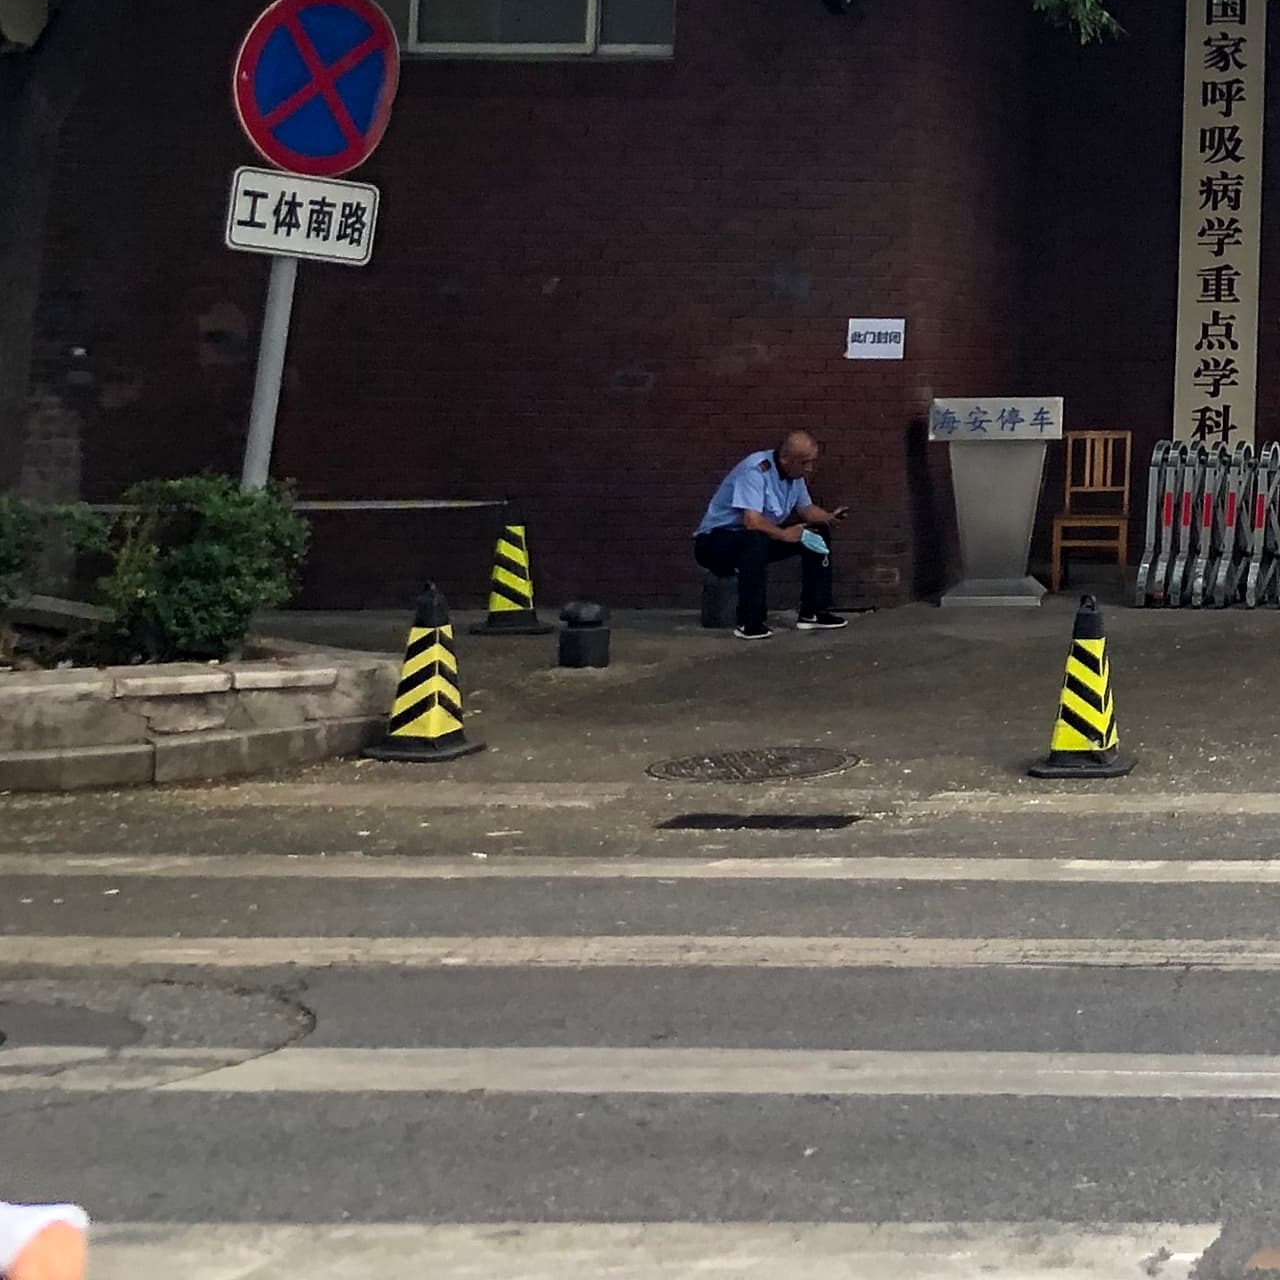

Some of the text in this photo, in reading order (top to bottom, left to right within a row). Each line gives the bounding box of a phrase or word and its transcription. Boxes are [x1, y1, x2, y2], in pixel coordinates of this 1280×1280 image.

[236, 189, 368, 247] 工体南路
[850, 330, 901, 344] 此门封闭
